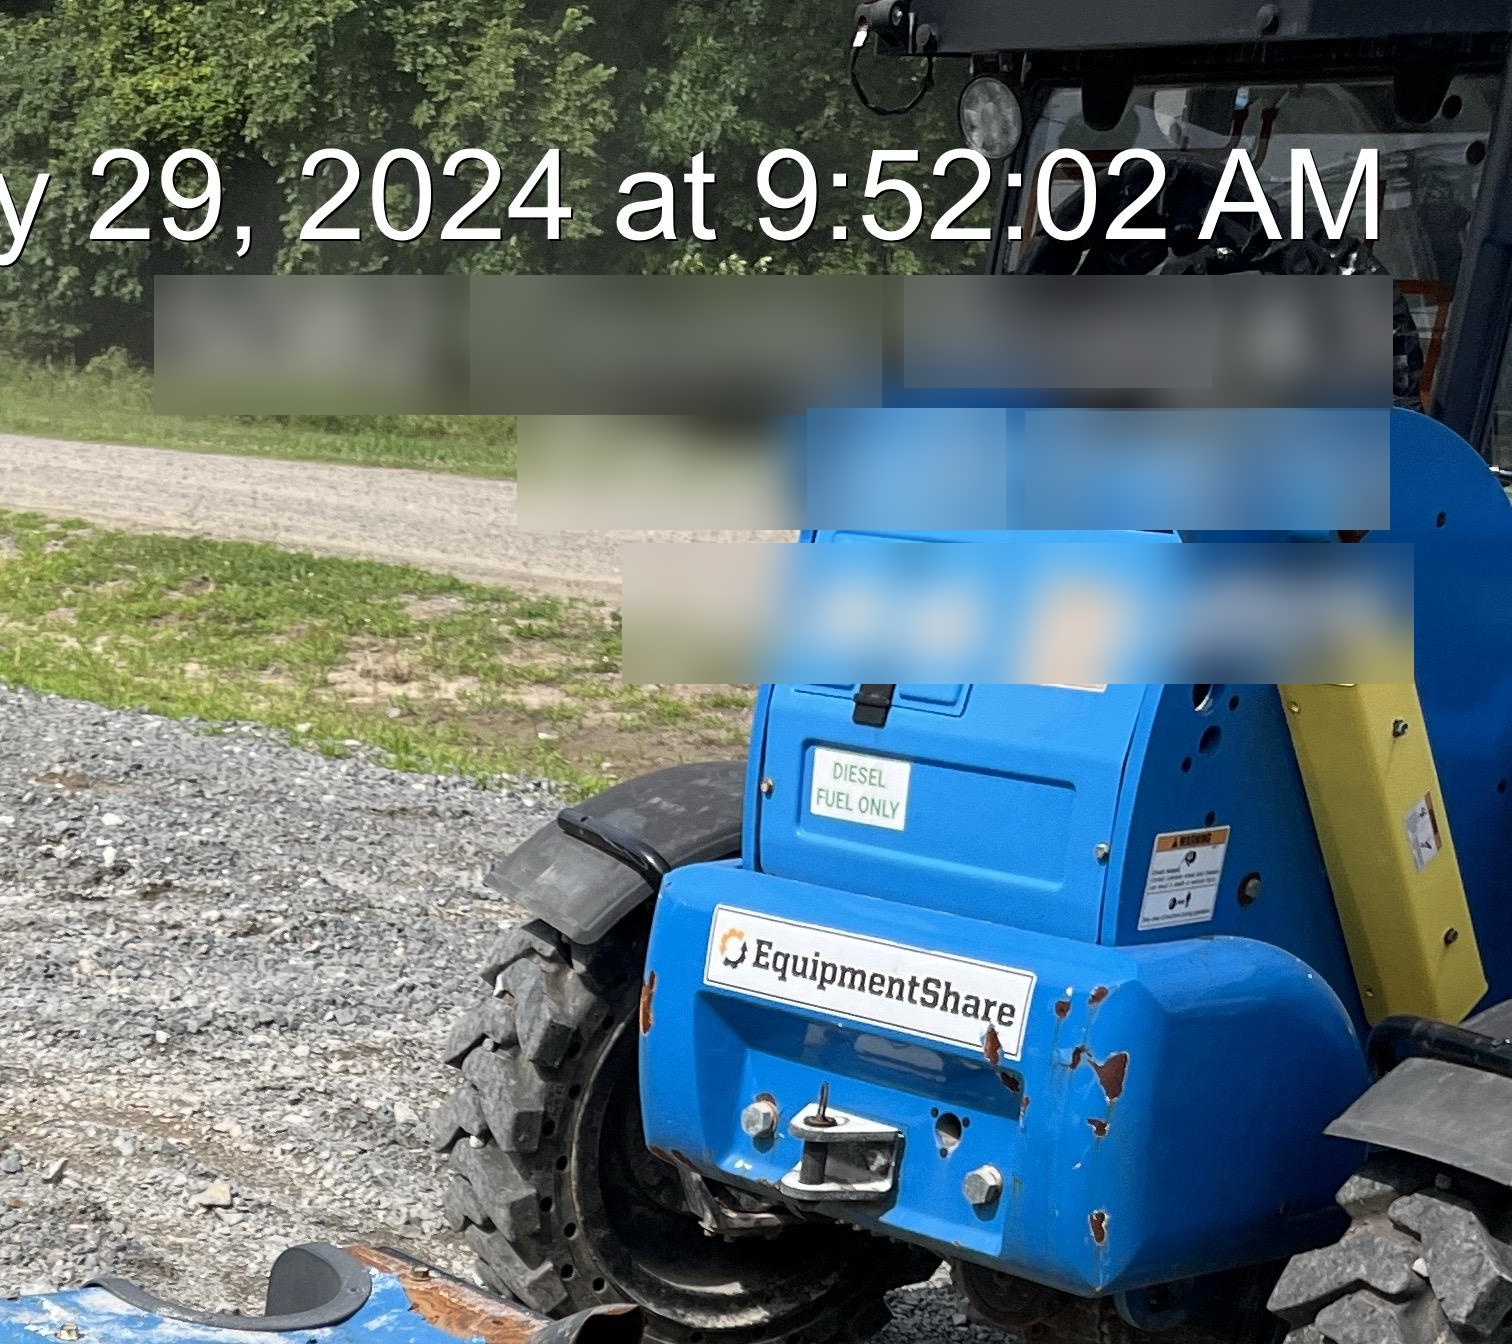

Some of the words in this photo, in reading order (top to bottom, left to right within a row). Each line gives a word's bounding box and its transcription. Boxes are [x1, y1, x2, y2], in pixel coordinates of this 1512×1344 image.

[833, 762, 886, 788] DIESEL
[816, 787, 853, 812] FUEL
[858, 796, 900, 819] ONLY
[752, 938, 1016, 1027] EquipmentShare
